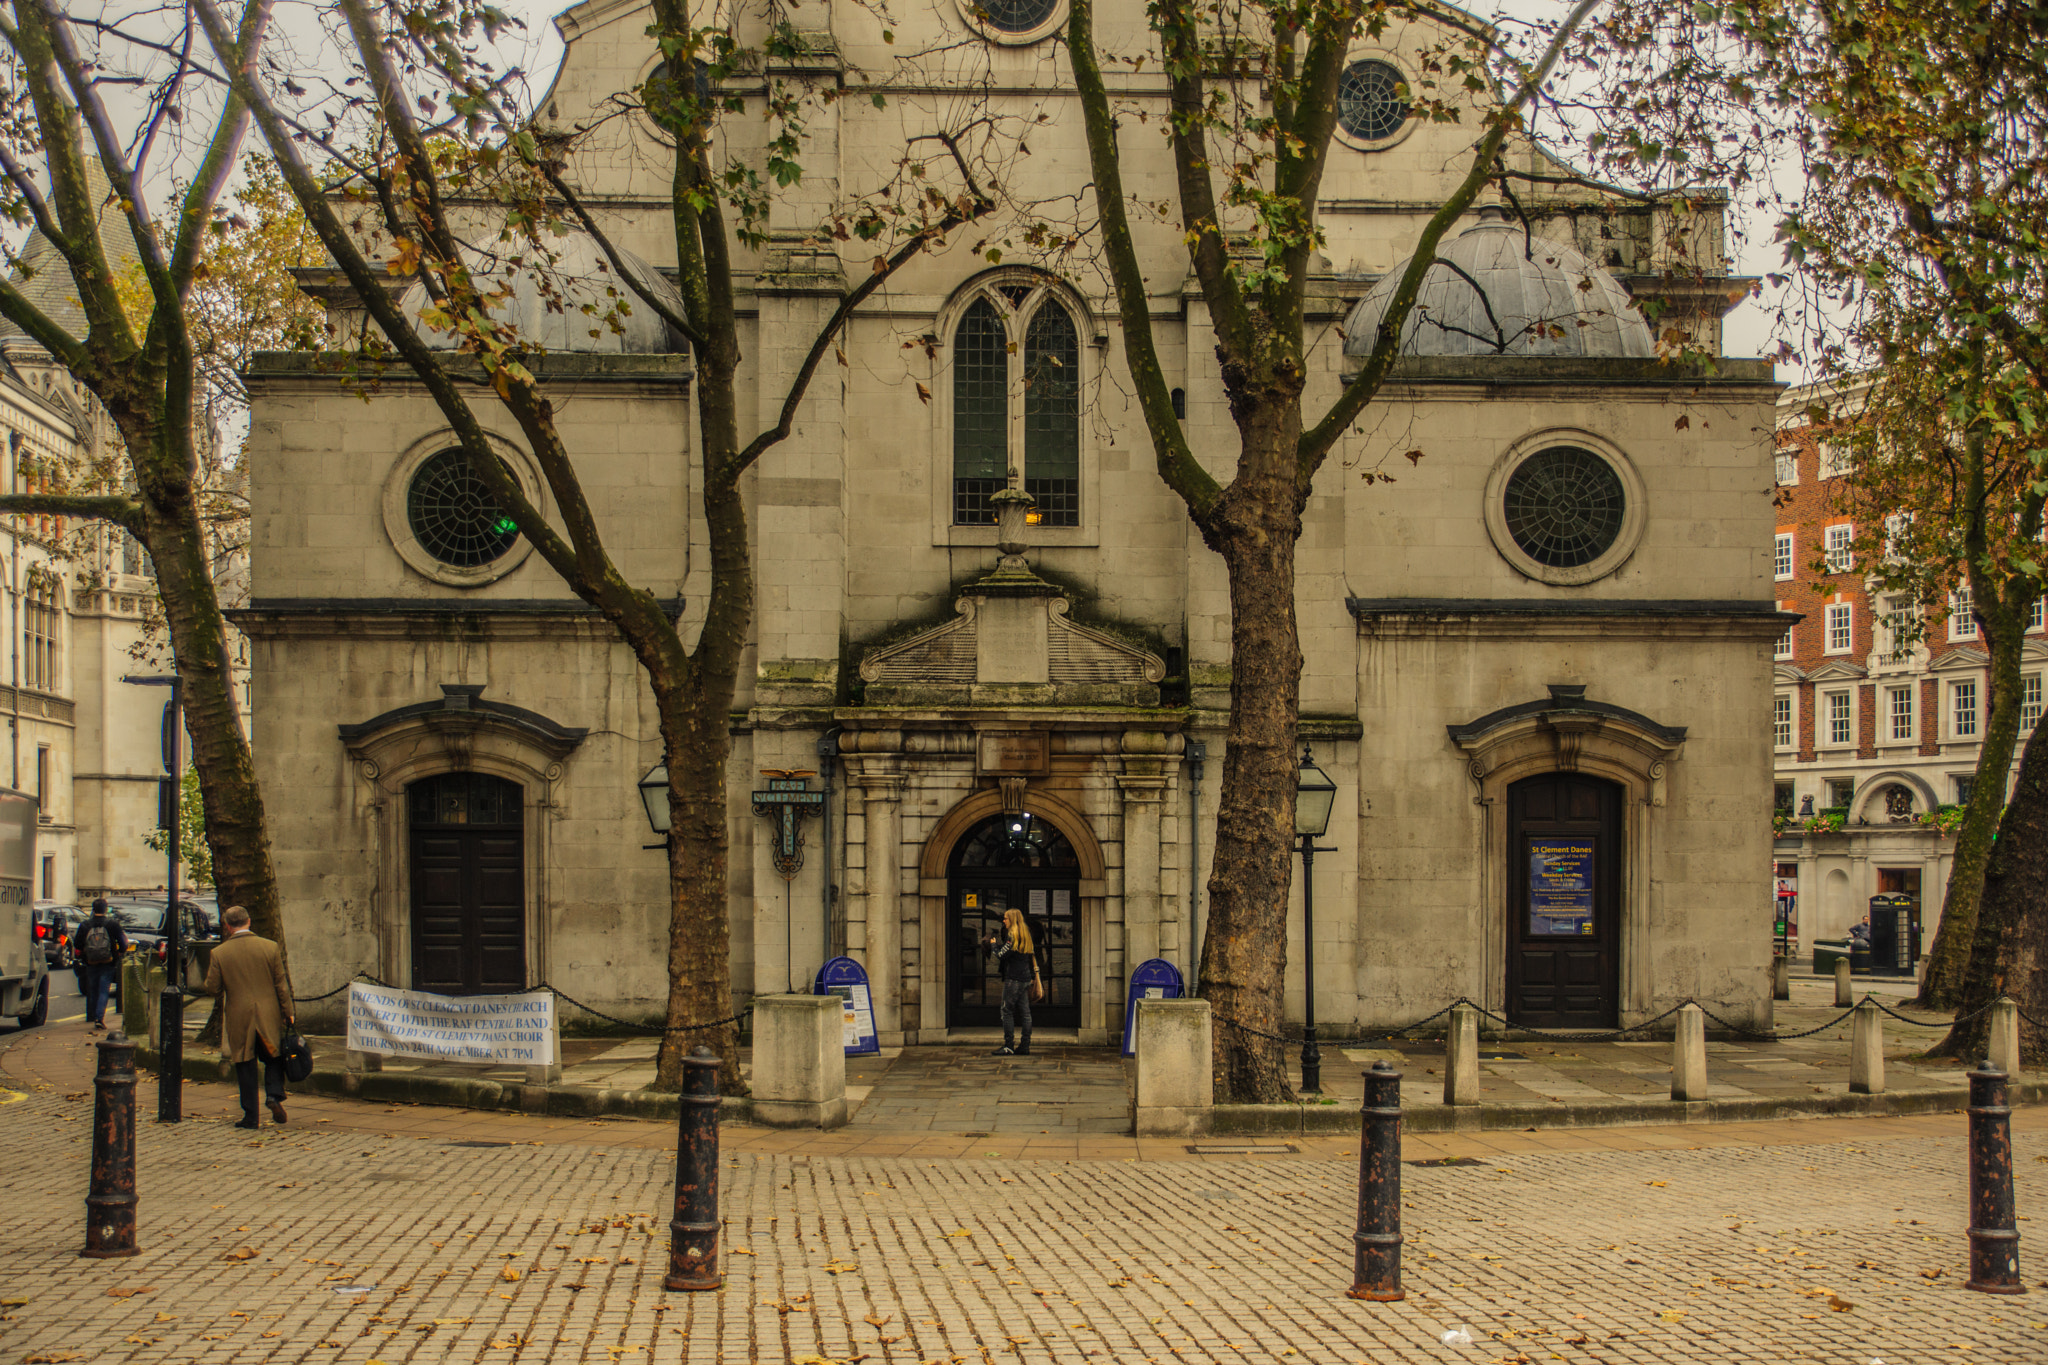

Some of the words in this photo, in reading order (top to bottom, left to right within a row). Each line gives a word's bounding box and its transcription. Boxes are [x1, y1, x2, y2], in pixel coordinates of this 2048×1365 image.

[765, 792, 821, 802] CLEMENT
[784, 805, 794, 853] DANES
[352, 991, 397, 1007] FRIENDS
[398, 999, 410, 1009] OF
[410, 1000, 423, 1011] ST
[422, 1001, 472, 1014] CLEMENT
[473, 1003, 509, 1014] DANES
[508, 1001, 548, 1014] CHURCH
[352, 1007, 399, 1022] CONCERT
[402, 1014, 428, 1026] WITH
[430, 1016, 452, 1028] THE
[452, 1018, 473, 1028] RAF
[475, 1018, 514, 1029] CENTRAL
[516, 1018, 548, 1029] BAND
[354, 1019, 405, 1036] SUPPORTED
[406, 1027, 422, 1037] BY
[422, 1029, 435, 1038] ST
[434, 1030, 481, 1041] CLEMENT
[481, 1031, 508, 1042] DANES
[509, 1031, 543, 1042] CHOIR
[360, 1036, 410, 1052] THURSDAY
[411, 1043, 434, 1054] 24TH
[436, 1045, 492, 1058] NOVEMBER
[496, 1048, 510, 1059] AT
[512, 1048, 533, 1059] 7PM
